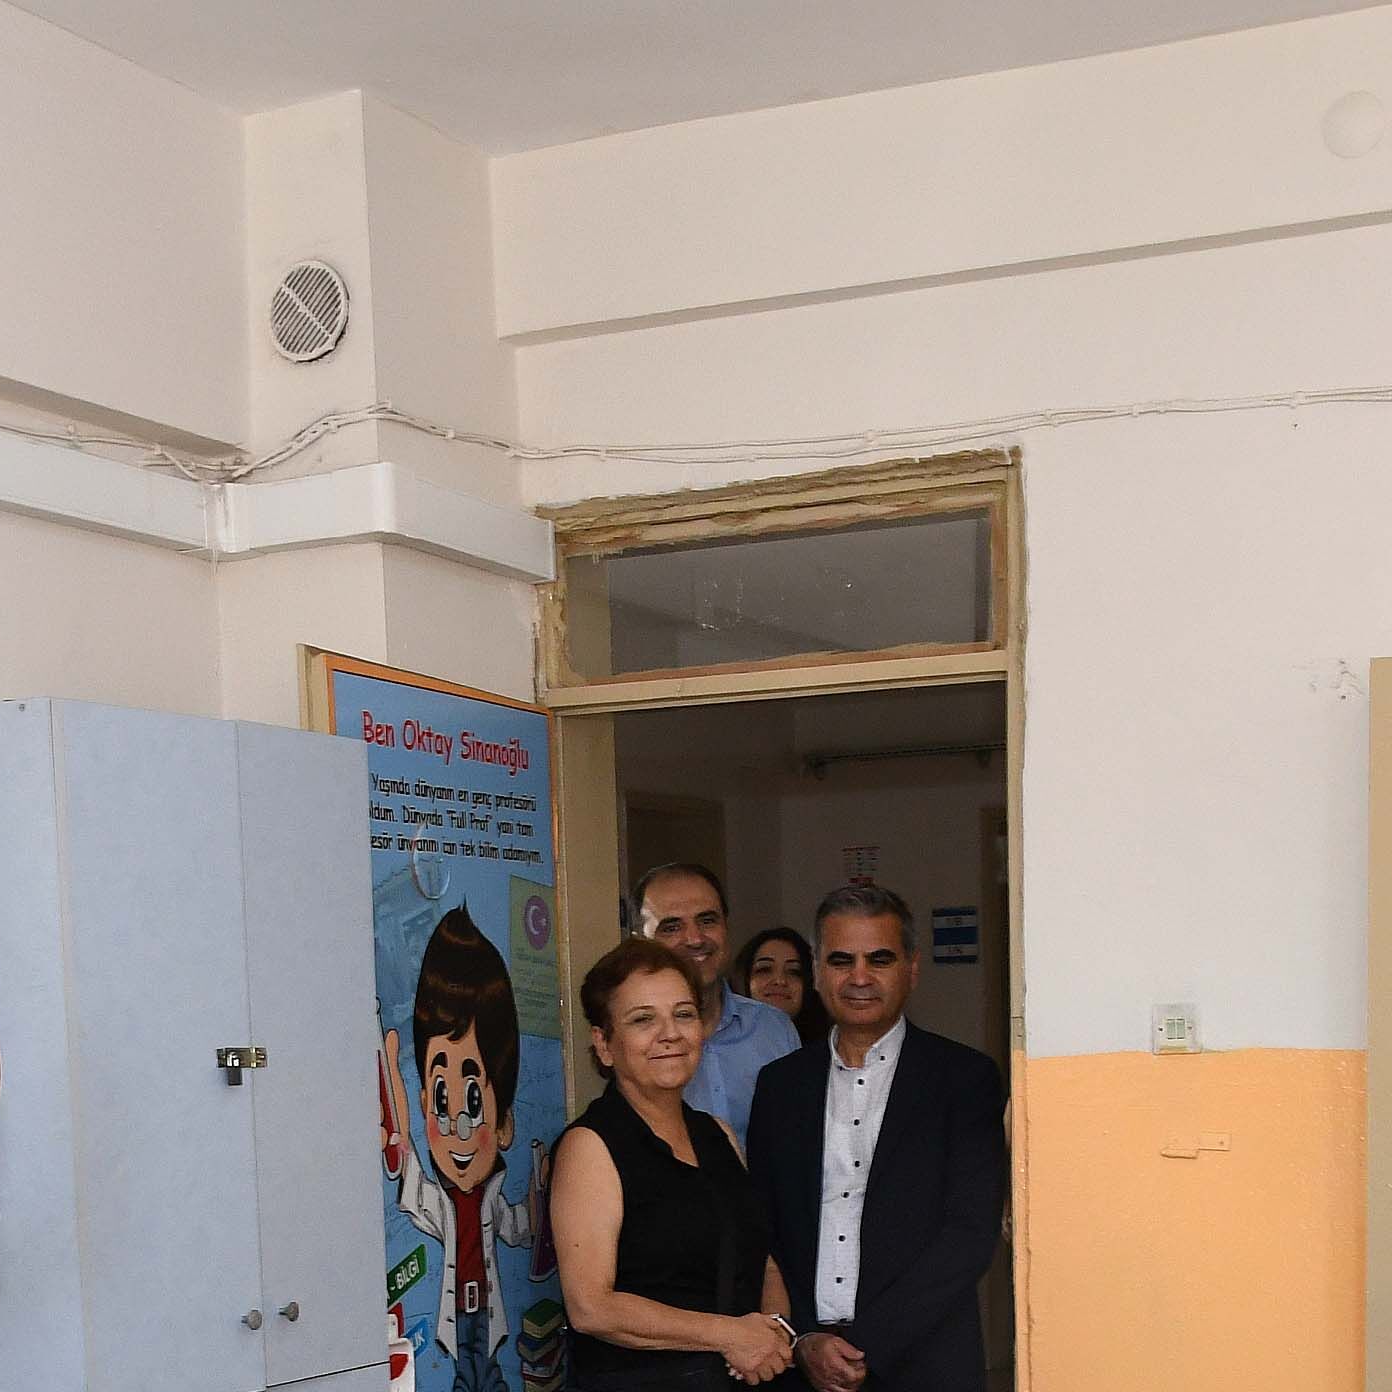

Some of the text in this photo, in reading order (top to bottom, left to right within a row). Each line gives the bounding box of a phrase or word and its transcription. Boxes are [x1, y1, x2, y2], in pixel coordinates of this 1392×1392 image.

[362, 711, 530, 776] Ben Oktay Sinanoğlu
[458, 789, 469, 802] en
[472, 791, 492, 810] genç
[368, 800, 398, 823] ldum.
[517, 822, 535, 837] tam
[460, 839, 476, 857] tek
[479, 841, 500, 860] bilim
[394, 1254, 420, 1290] BİLGİ
